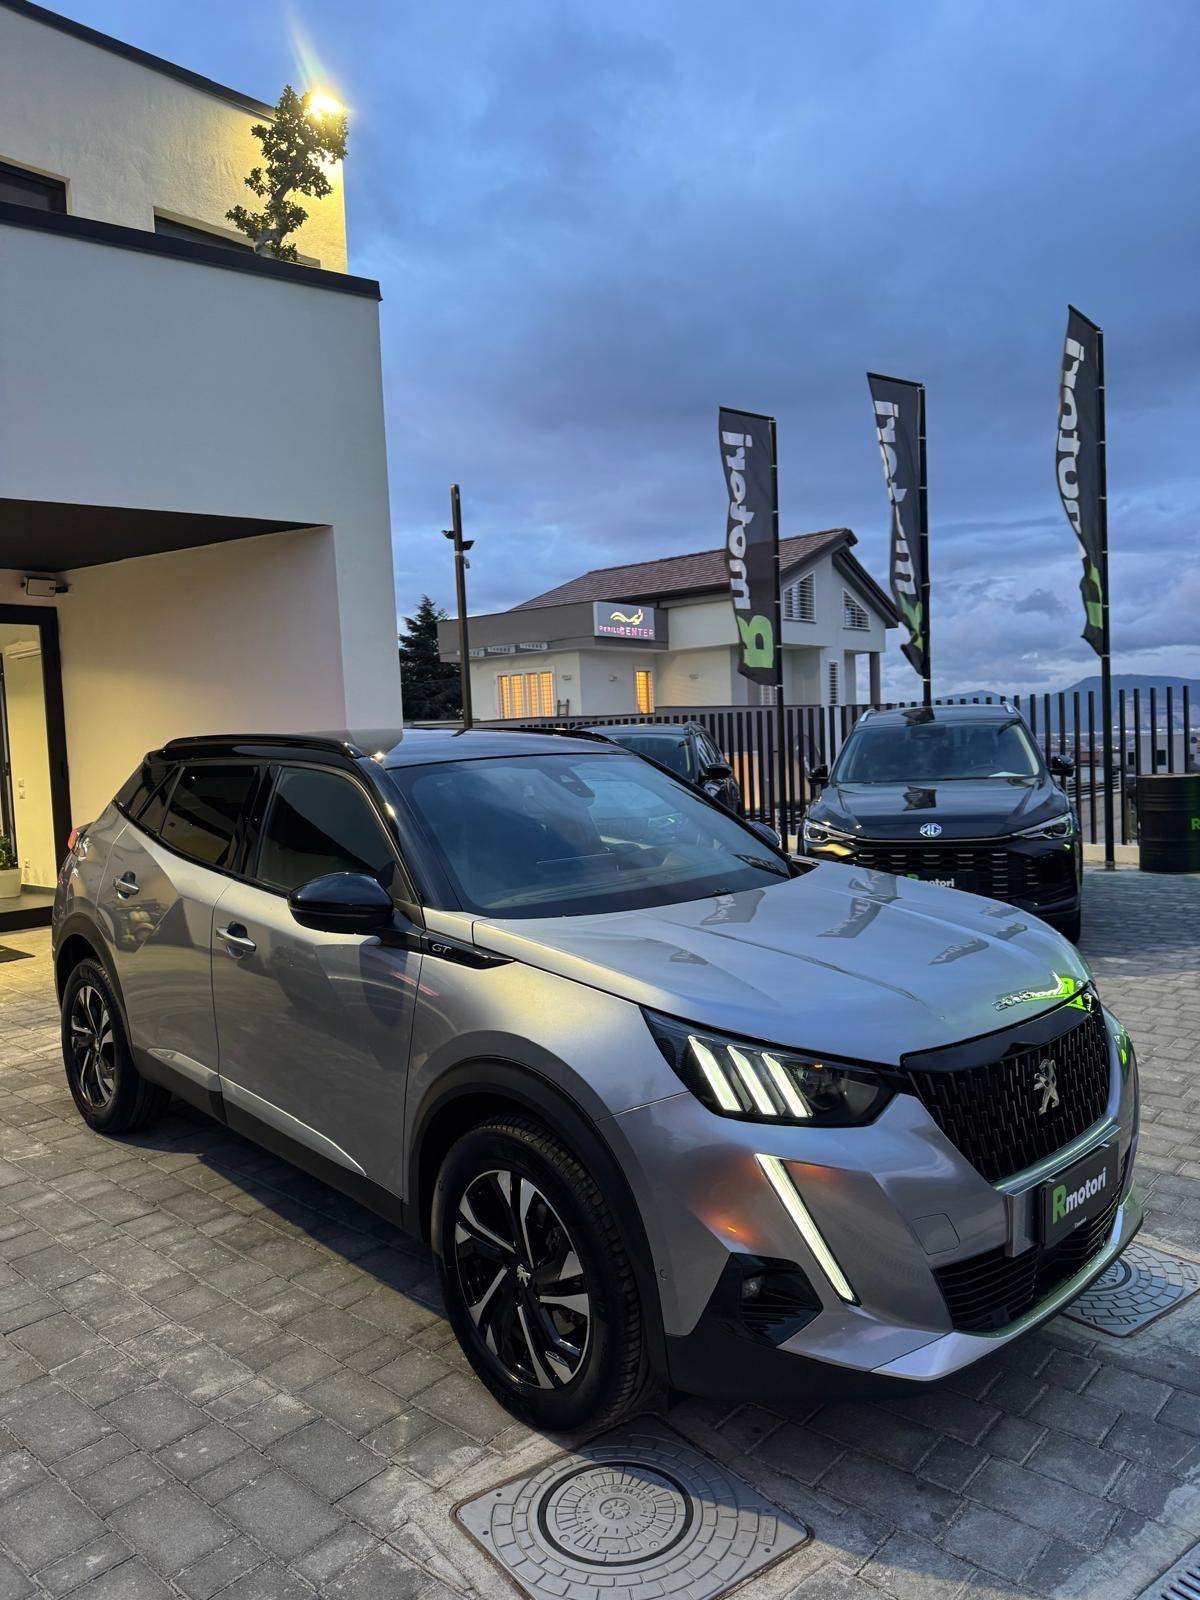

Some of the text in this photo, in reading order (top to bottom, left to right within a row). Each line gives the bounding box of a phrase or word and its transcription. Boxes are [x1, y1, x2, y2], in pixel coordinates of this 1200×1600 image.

[920, 823, 942, 837] MG
[431, 943, 452, 954] GT
[1052, 1166, 1107, 1225] Rmotori
